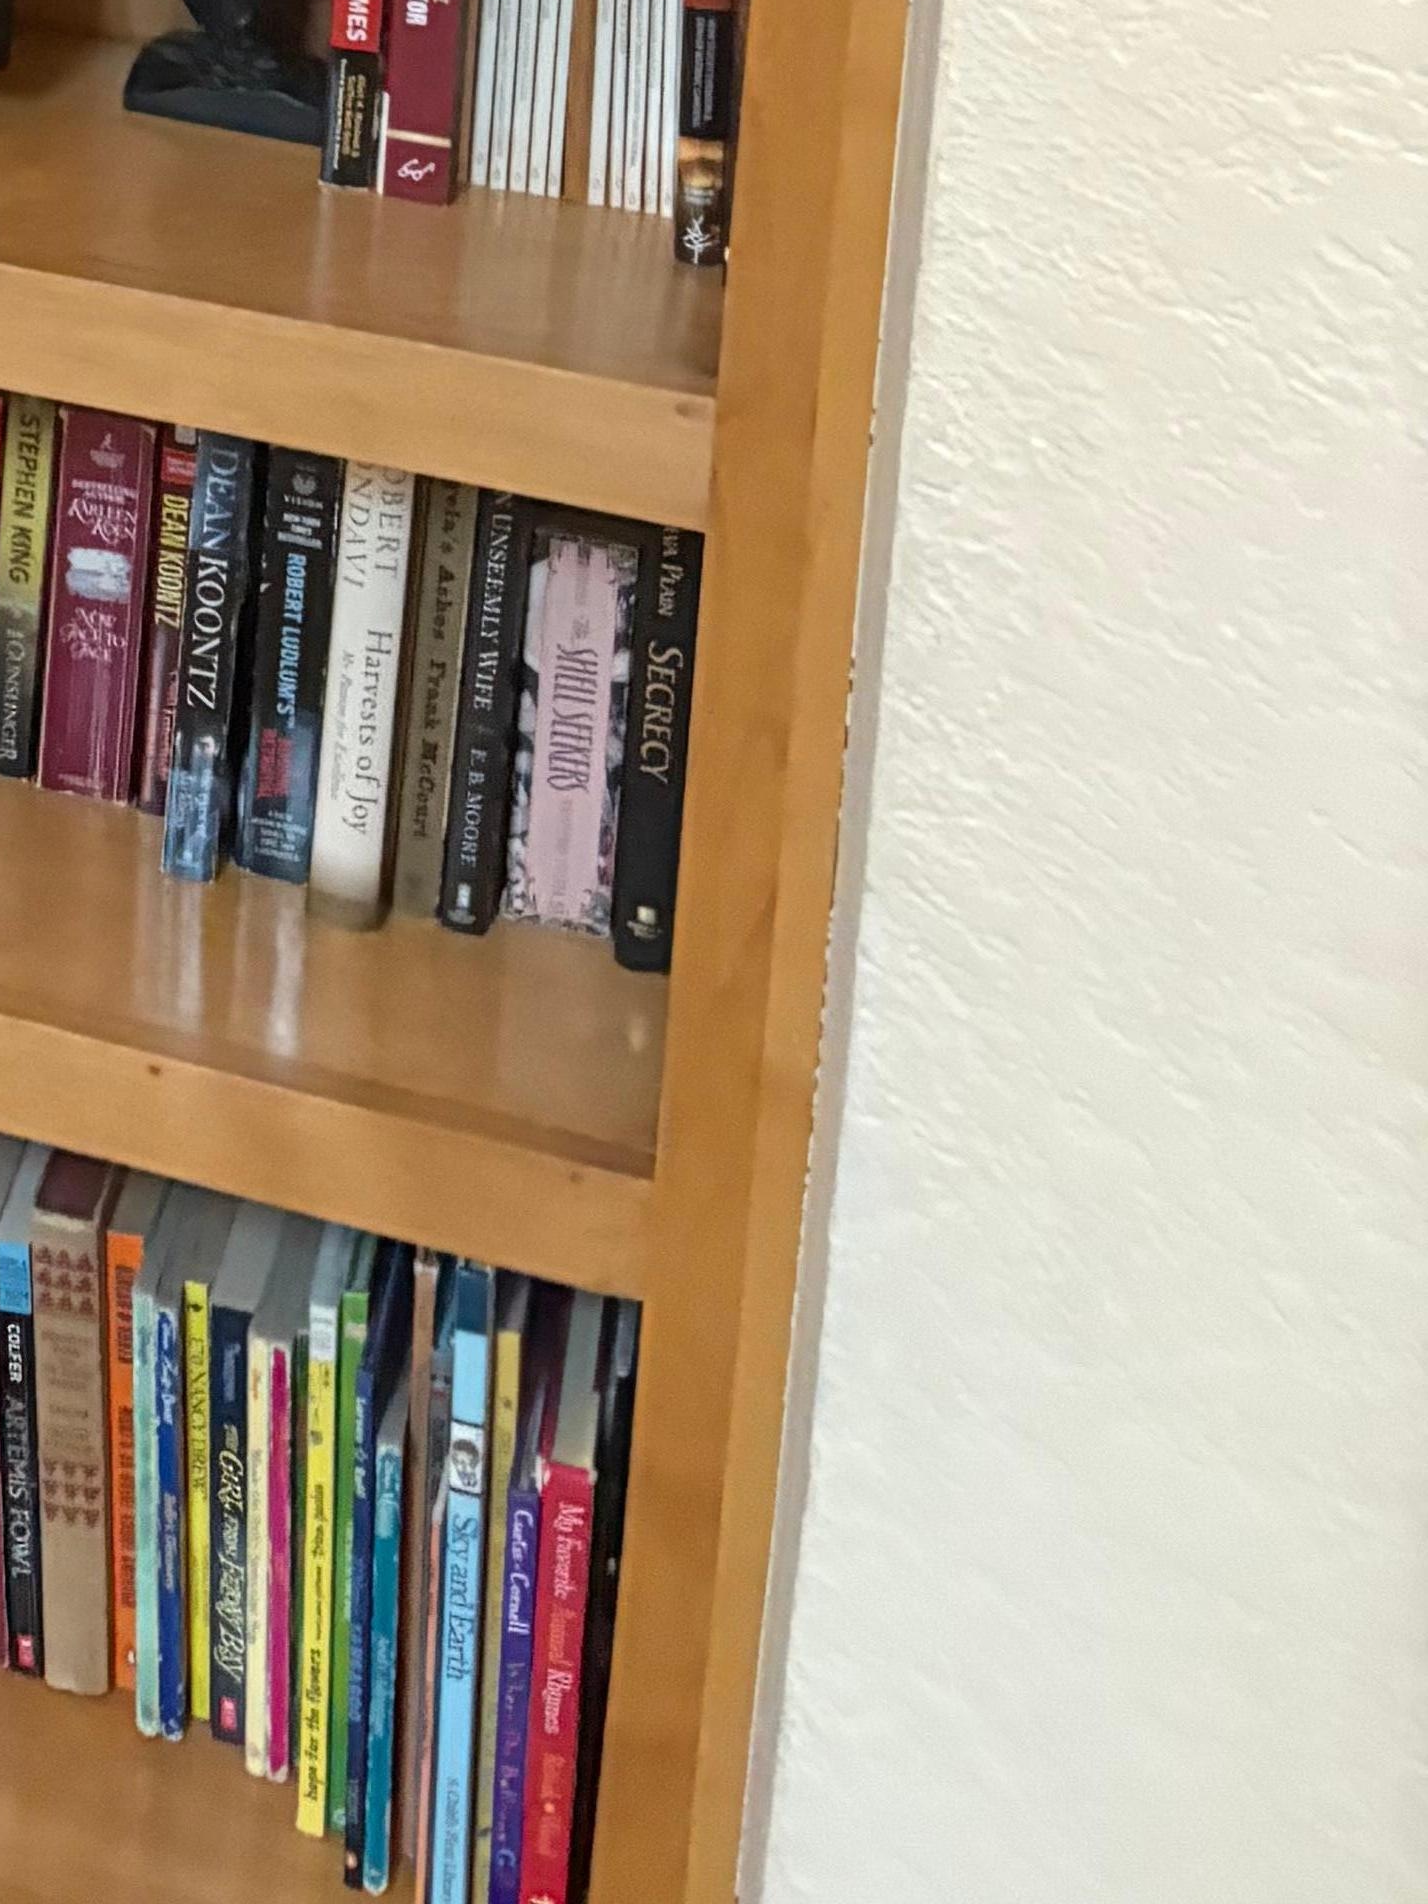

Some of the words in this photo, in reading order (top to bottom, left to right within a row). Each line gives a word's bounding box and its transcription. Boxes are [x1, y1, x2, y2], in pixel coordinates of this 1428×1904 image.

[13, 412, 40, 520] STEPHEN
[202, 446, 240, 551] DEAN
[7, 525, 33, 584] KING
[163, 492, 189, 546] DEAN
[154, 547, 184, 628] KOONTZ
[478, 513, 513, 645] UNSEEMLY
[187, 554, 229, 710] KOONTZ
[471, 651, 501, 711] WIFE
[639, 640, 684, 786] SECRECY
[5, 1322, 22, 1384] COLFER
[3, 1395, 34, 1503] ARTEMIS
[8, 1507, 35, 1578] FOWL
[453, 1511, 480, 1557] Sky
[450, 1561, 480, 1598] and
[443, 1598, 478, 1682] Earth
